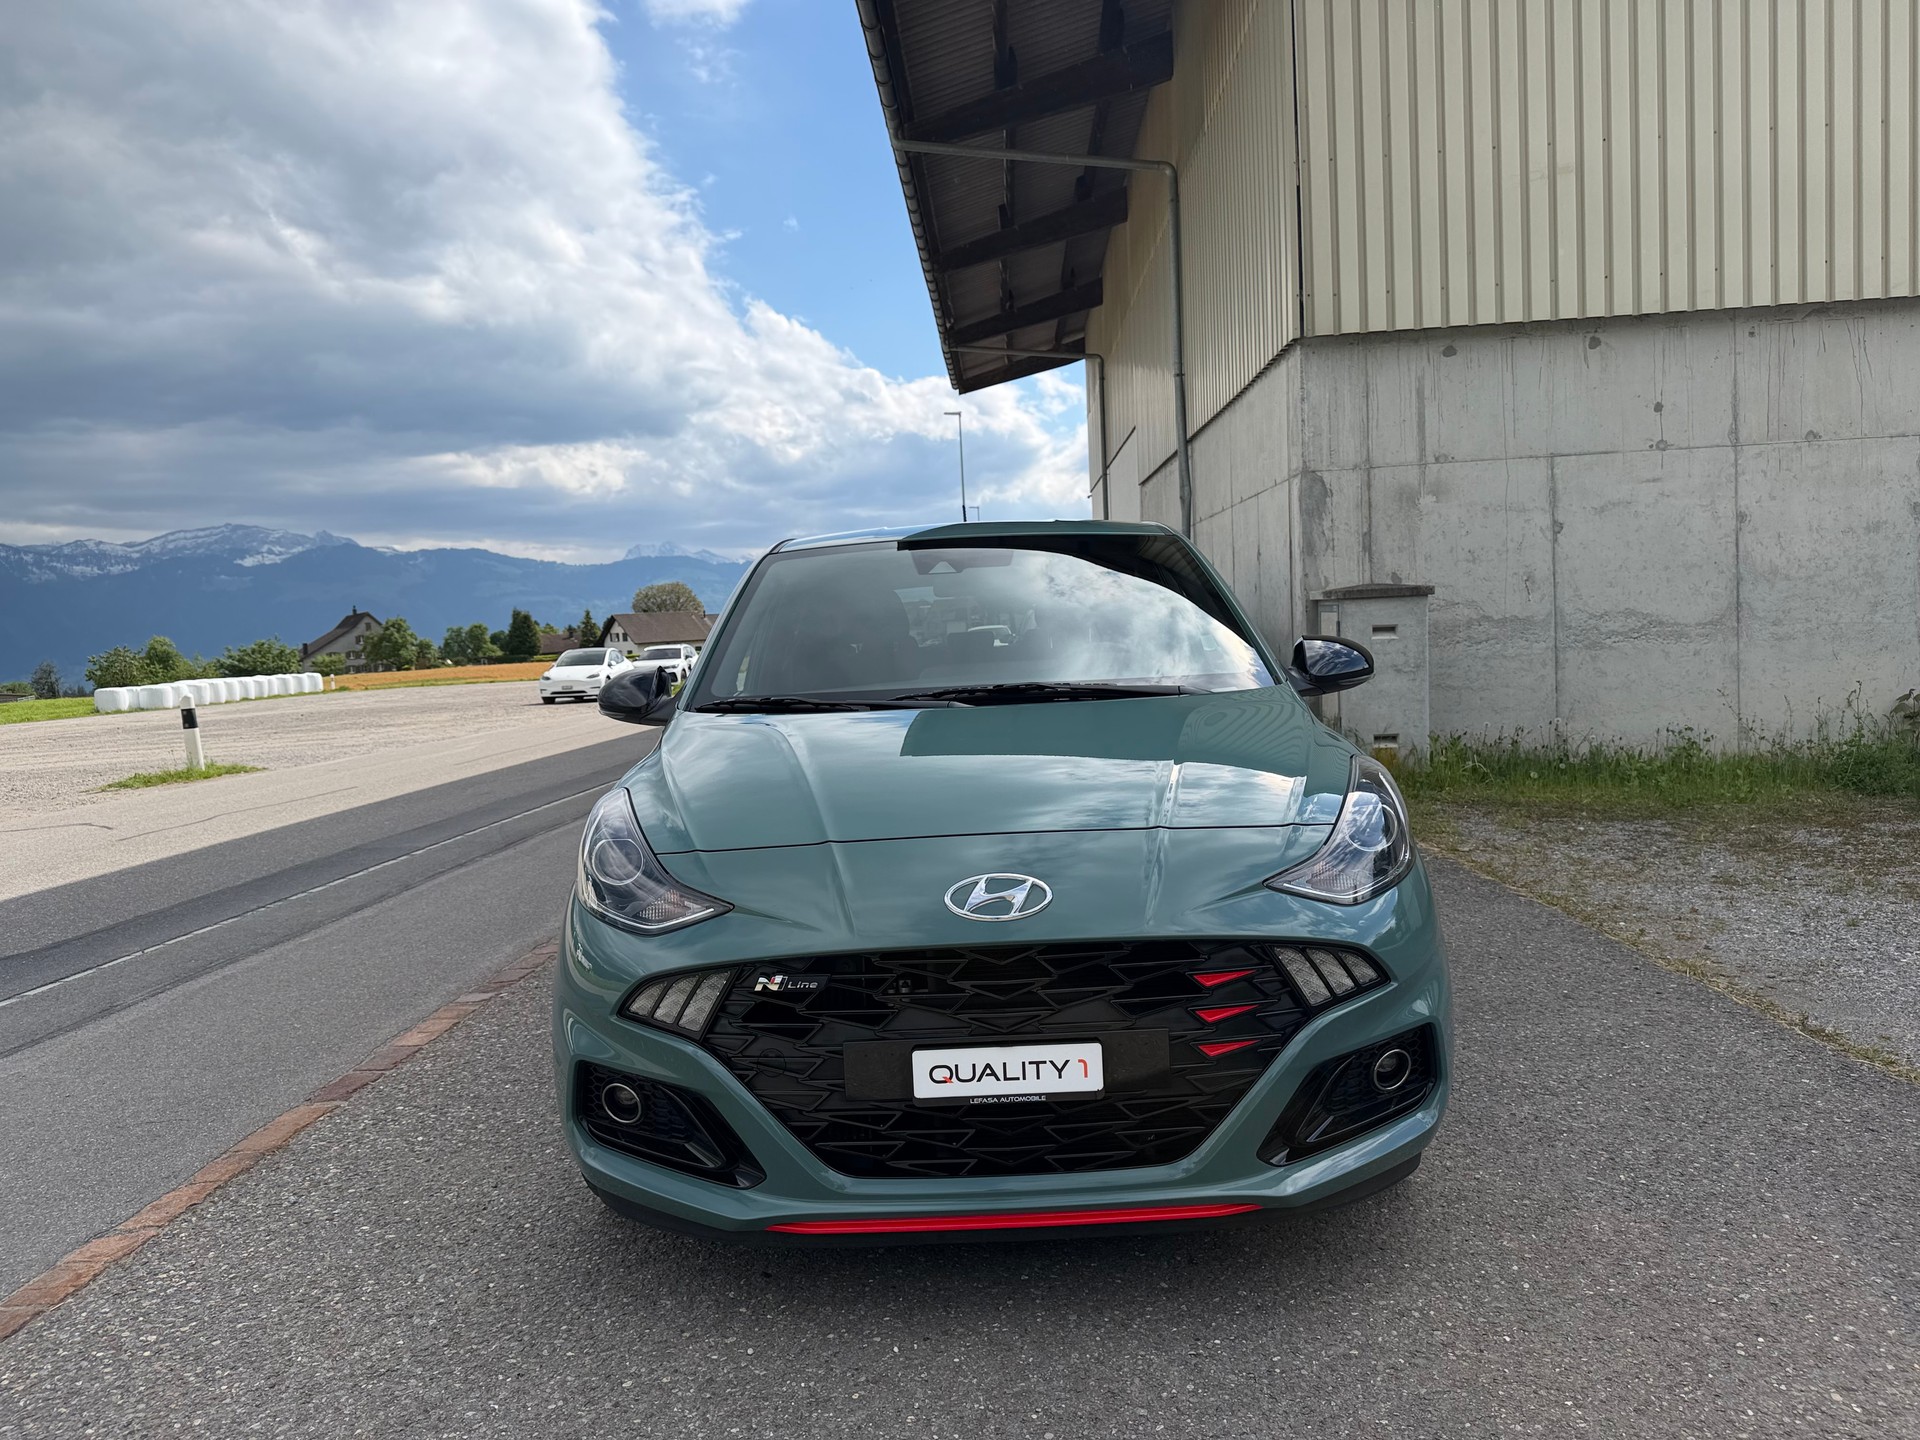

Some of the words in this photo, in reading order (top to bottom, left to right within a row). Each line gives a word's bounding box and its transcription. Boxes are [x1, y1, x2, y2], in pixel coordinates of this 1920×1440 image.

[754, 975, 784, 991] N
[928, 1059, 1071, 1084] QUALITY
[1077, 1058, 1089, 1078] 1
[1000, 1095, 1046, 1103] AUTOMOBILE
